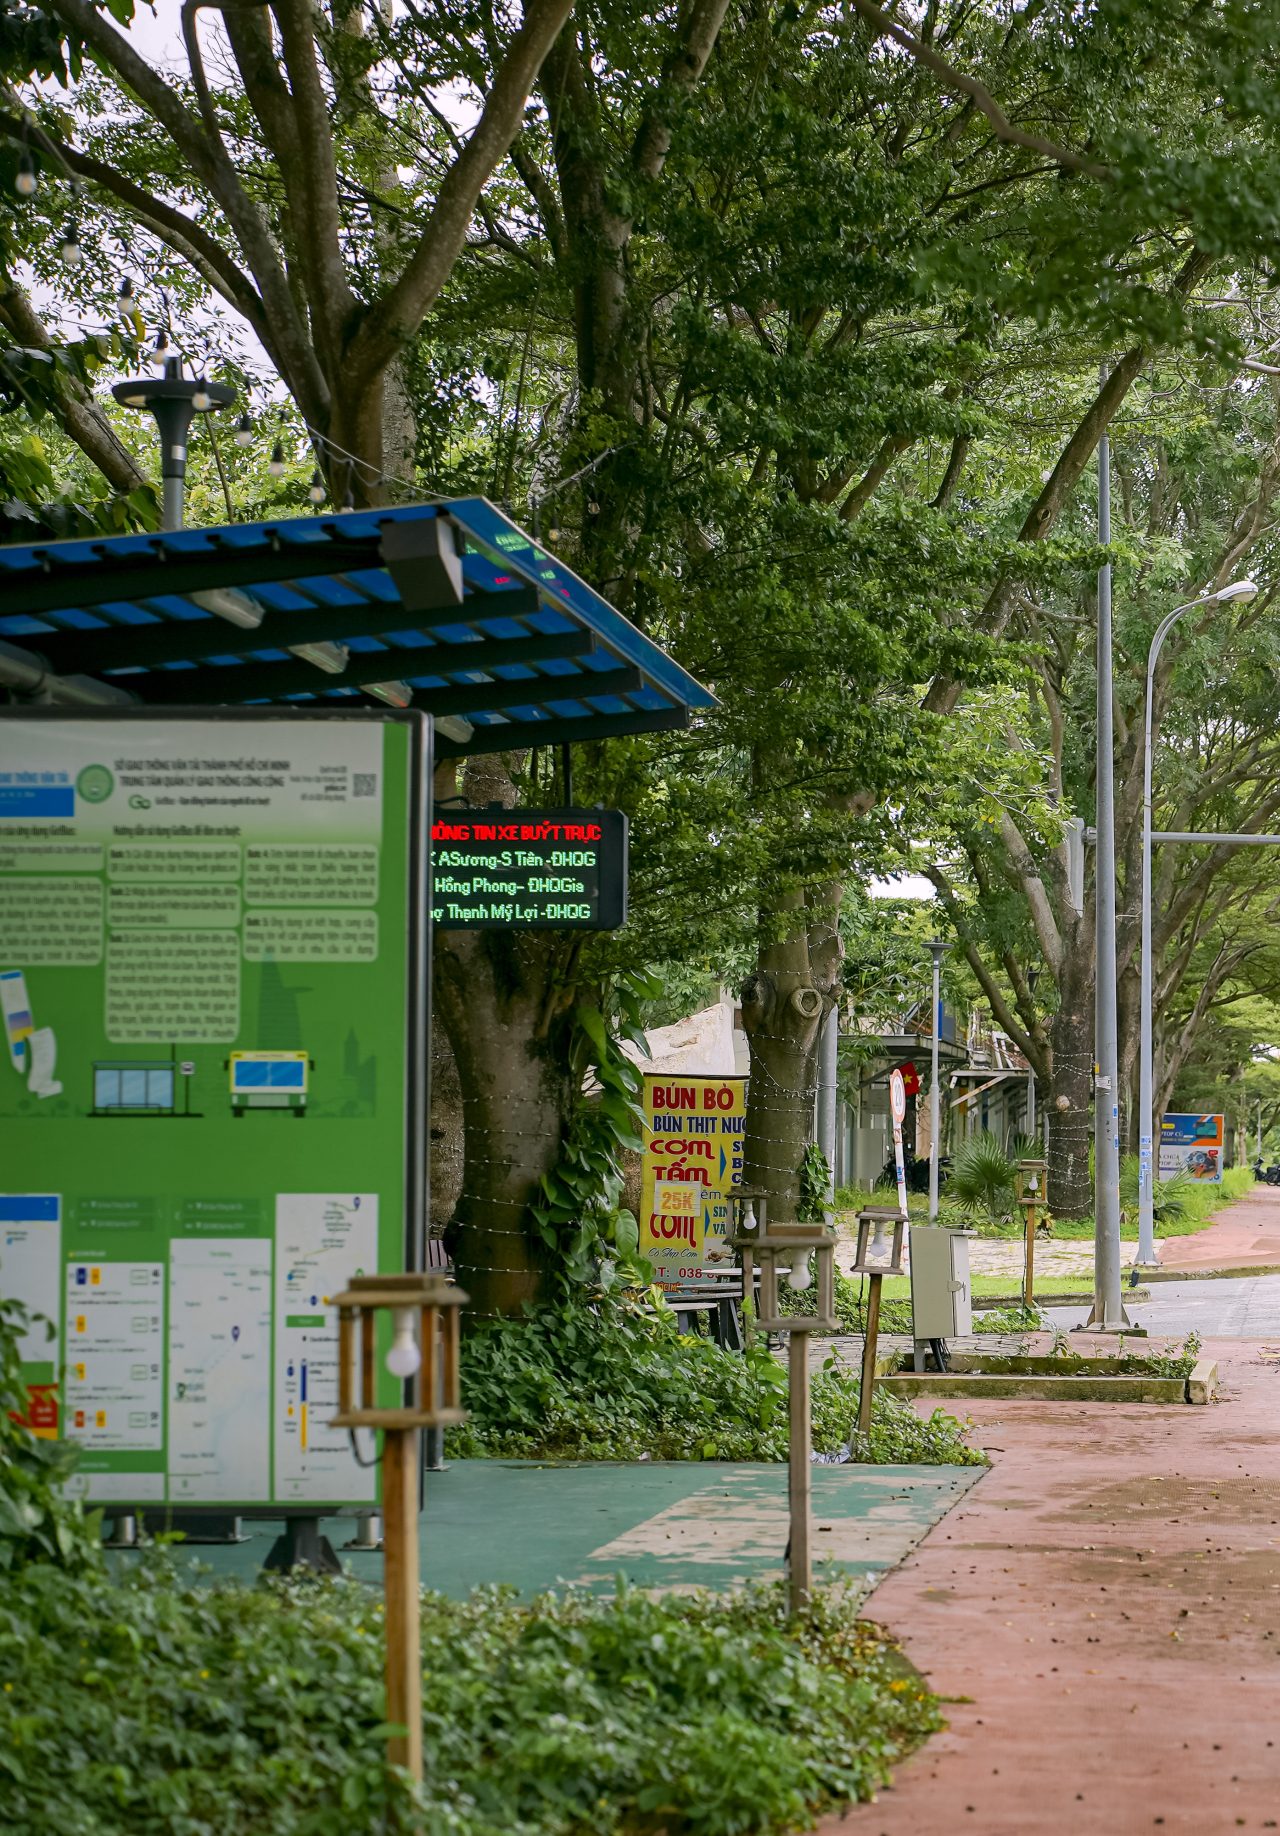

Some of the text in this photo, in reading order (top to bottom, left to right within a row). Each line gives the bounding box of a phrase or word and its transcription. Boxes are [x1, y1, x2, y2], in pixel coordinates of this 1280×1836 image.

[472, 825, 496, 841] TIN
[498, 825, 519, 841] XE
[434, 876, 471, 896] Hồng
[447, 904, 489, 922] Thạnh
[491, 904, 514, 922] Mỹ
[515, 904, 539, 922] Lợi
[652, 1082, 735, 1110] BÚN BÒ
[653, 1112, 682, 1132] BÚN
[687, 1116, 717, 1137] THỊT
[661, 1191, 694, 1210] 25K
[678, 1267, 703, 1279] 038
